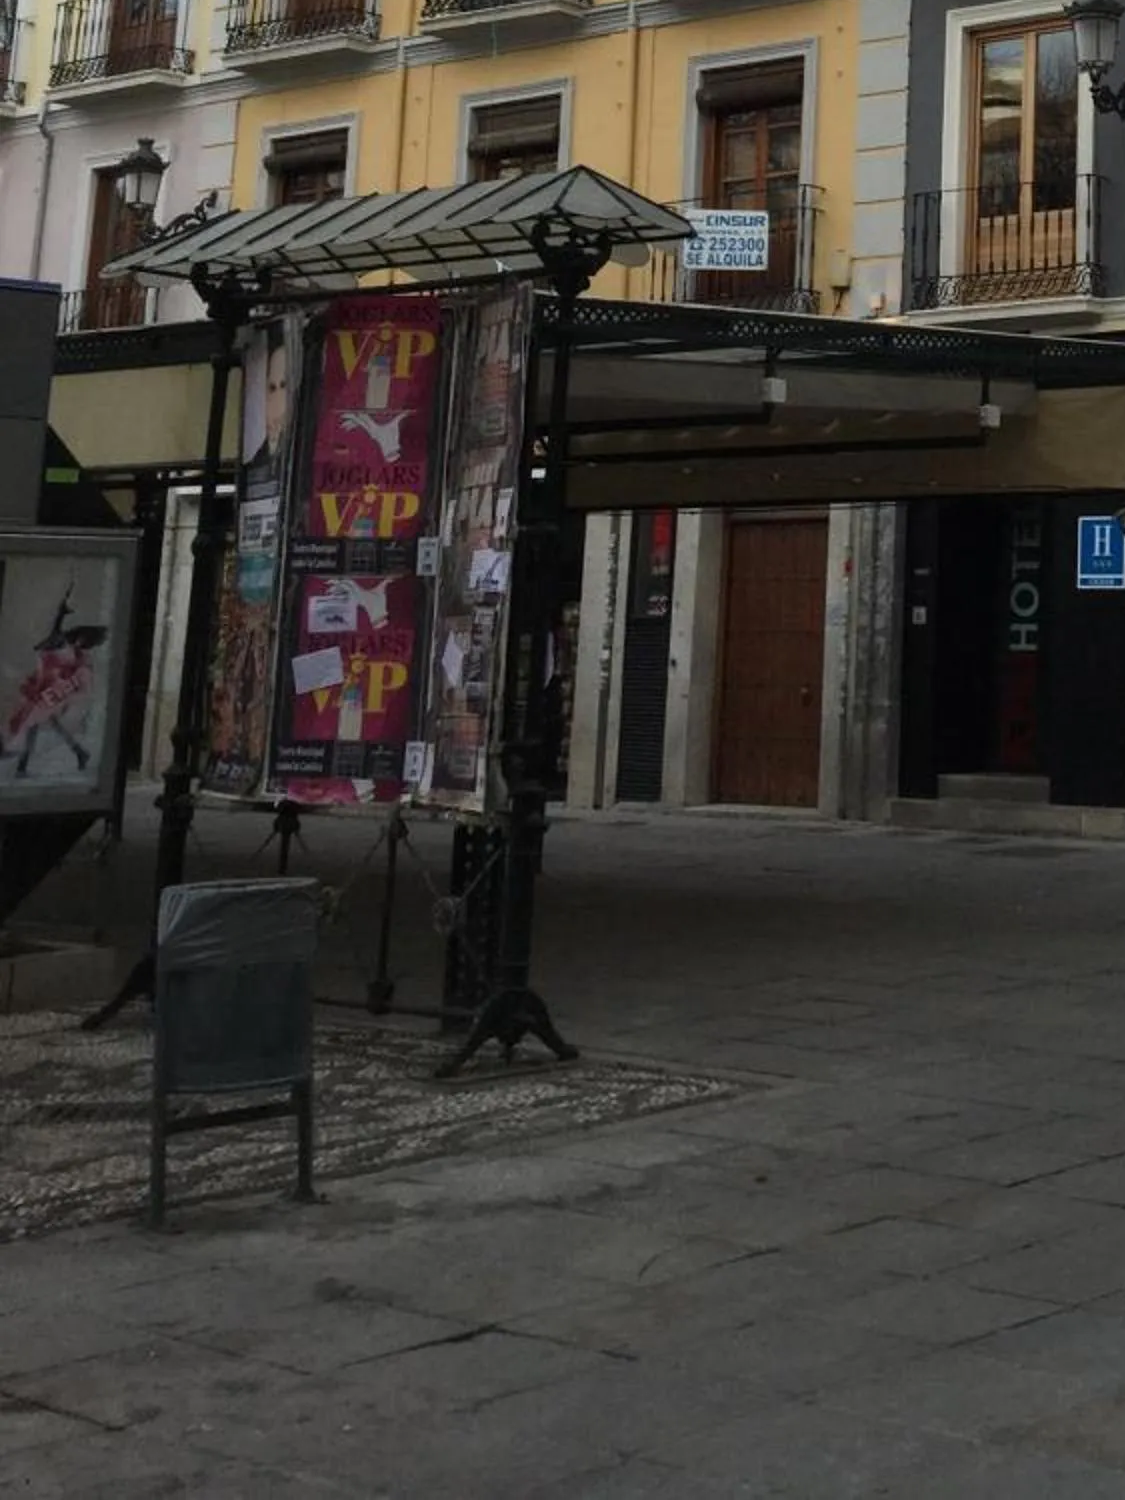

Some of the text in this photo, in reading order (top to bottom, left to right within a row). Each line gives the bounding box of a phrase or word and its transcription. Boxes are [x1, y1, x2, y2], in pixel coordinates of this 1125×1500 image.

[708, 237, 765, 252] 252300
[686, 252, 764, 267] SE ALQUILA
[316, 465, 421, 490] JOGLARS
[1091, 523, 1116, 557] H
